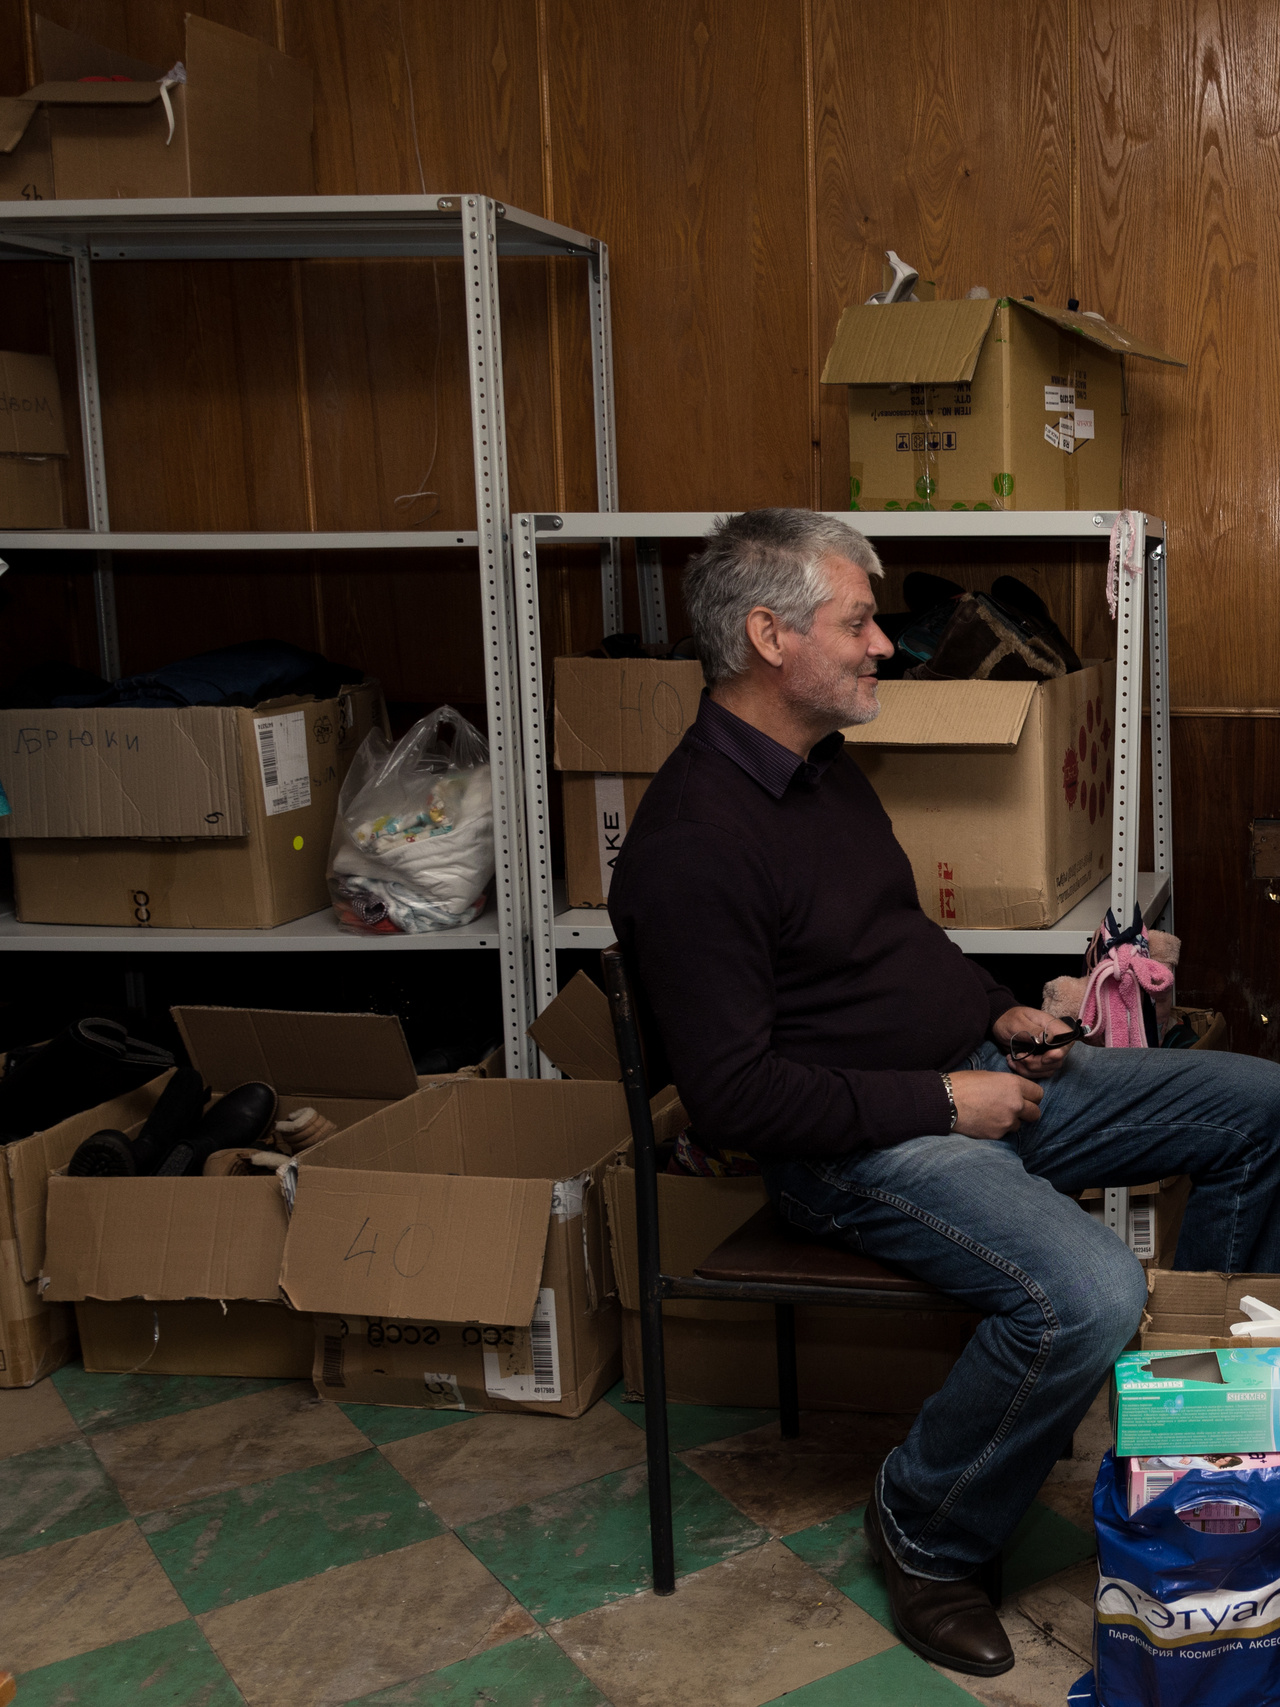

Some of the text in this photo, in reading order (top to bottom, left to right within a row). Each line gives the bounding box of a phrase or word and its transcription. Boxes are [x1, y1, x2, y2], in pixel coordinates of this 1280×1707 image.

[954, 407, 971, 416] ITEM
[620, 669, 684, 736] 40
[13, 728, 140, 755] БРЮКИ
[344, 1217, 435, 1278] 40
[1108, 1629, 1174, 1658] ПАРФЮМЕРИЯ
[1179, 1641, 1244, 1660] КОСМЕТИКА
